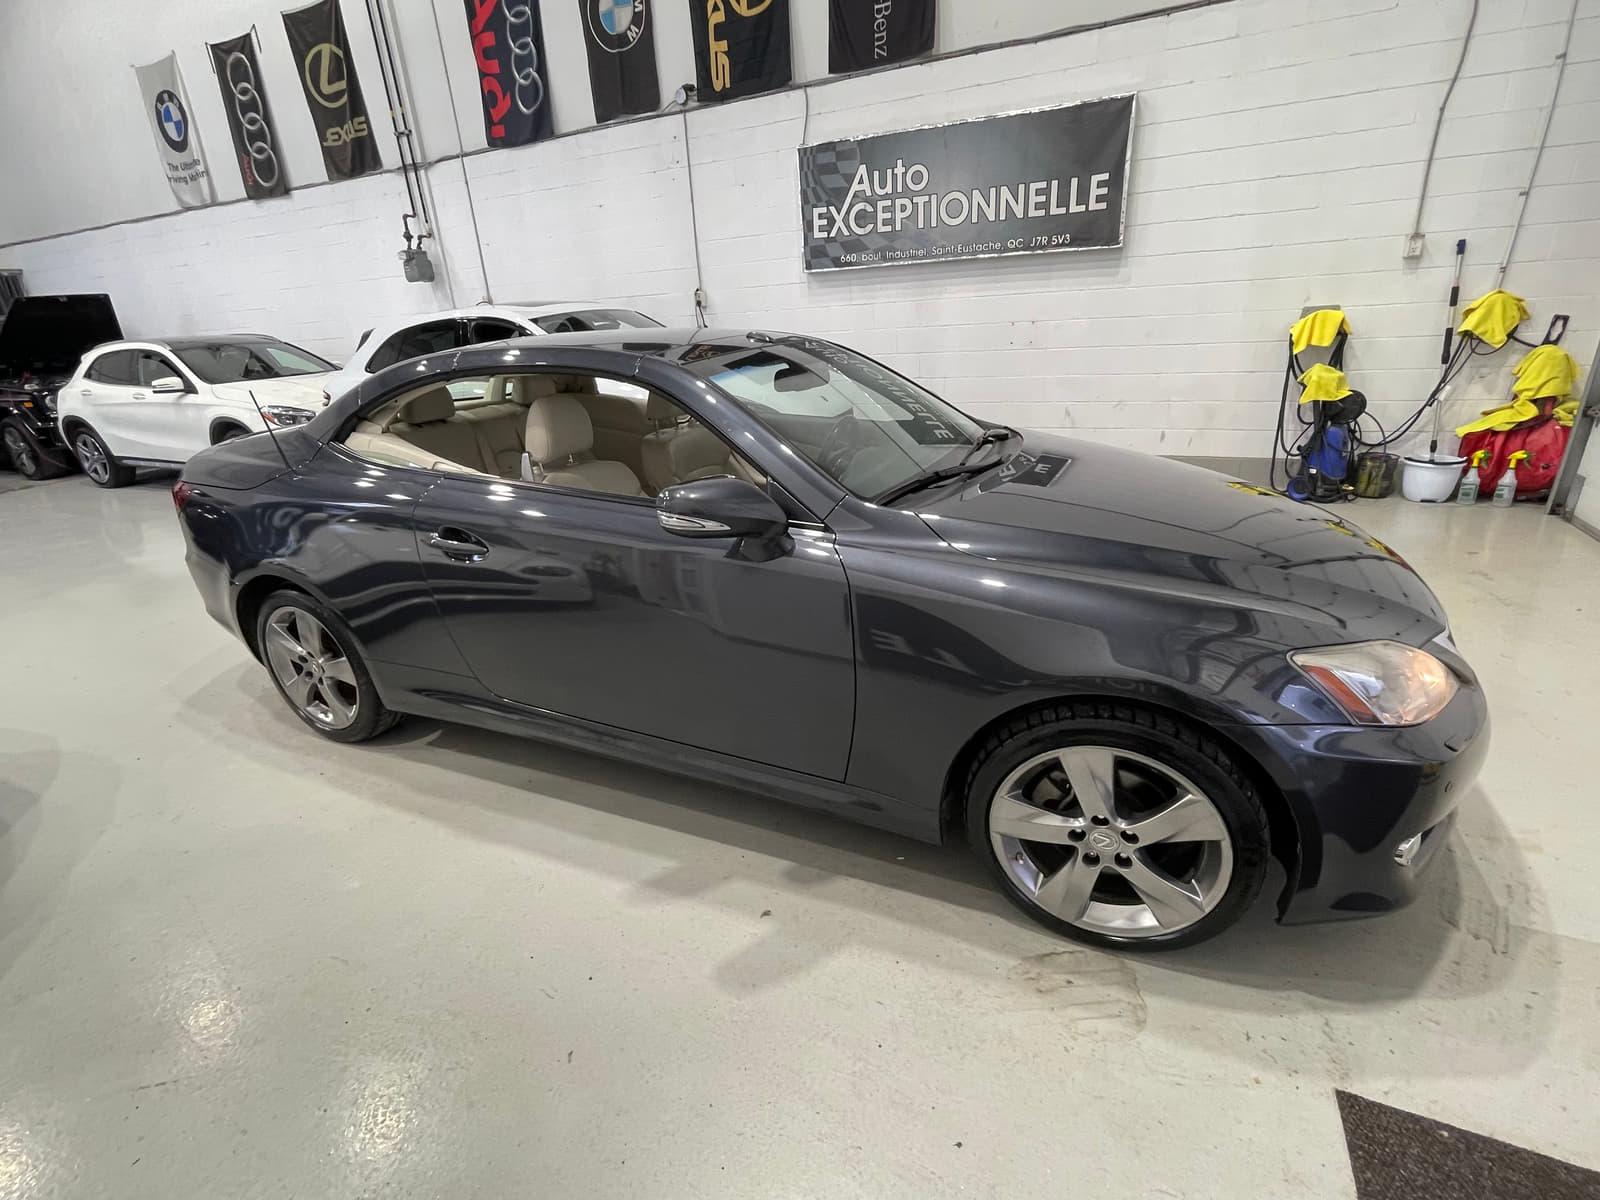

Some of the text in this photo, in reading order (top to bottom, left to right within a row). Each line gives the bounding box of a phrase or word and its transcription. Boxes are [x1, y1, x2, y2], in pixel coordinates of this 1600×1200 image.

[850, 158, 929, 198] Auto
[812, 173, 1110, 239] EXCEPTIONNELLE
[1007, 238, 1024, 249] QC
[1030, 236, 1048, 247] J7R
[1051, 233, 1071, 245] 5V3
